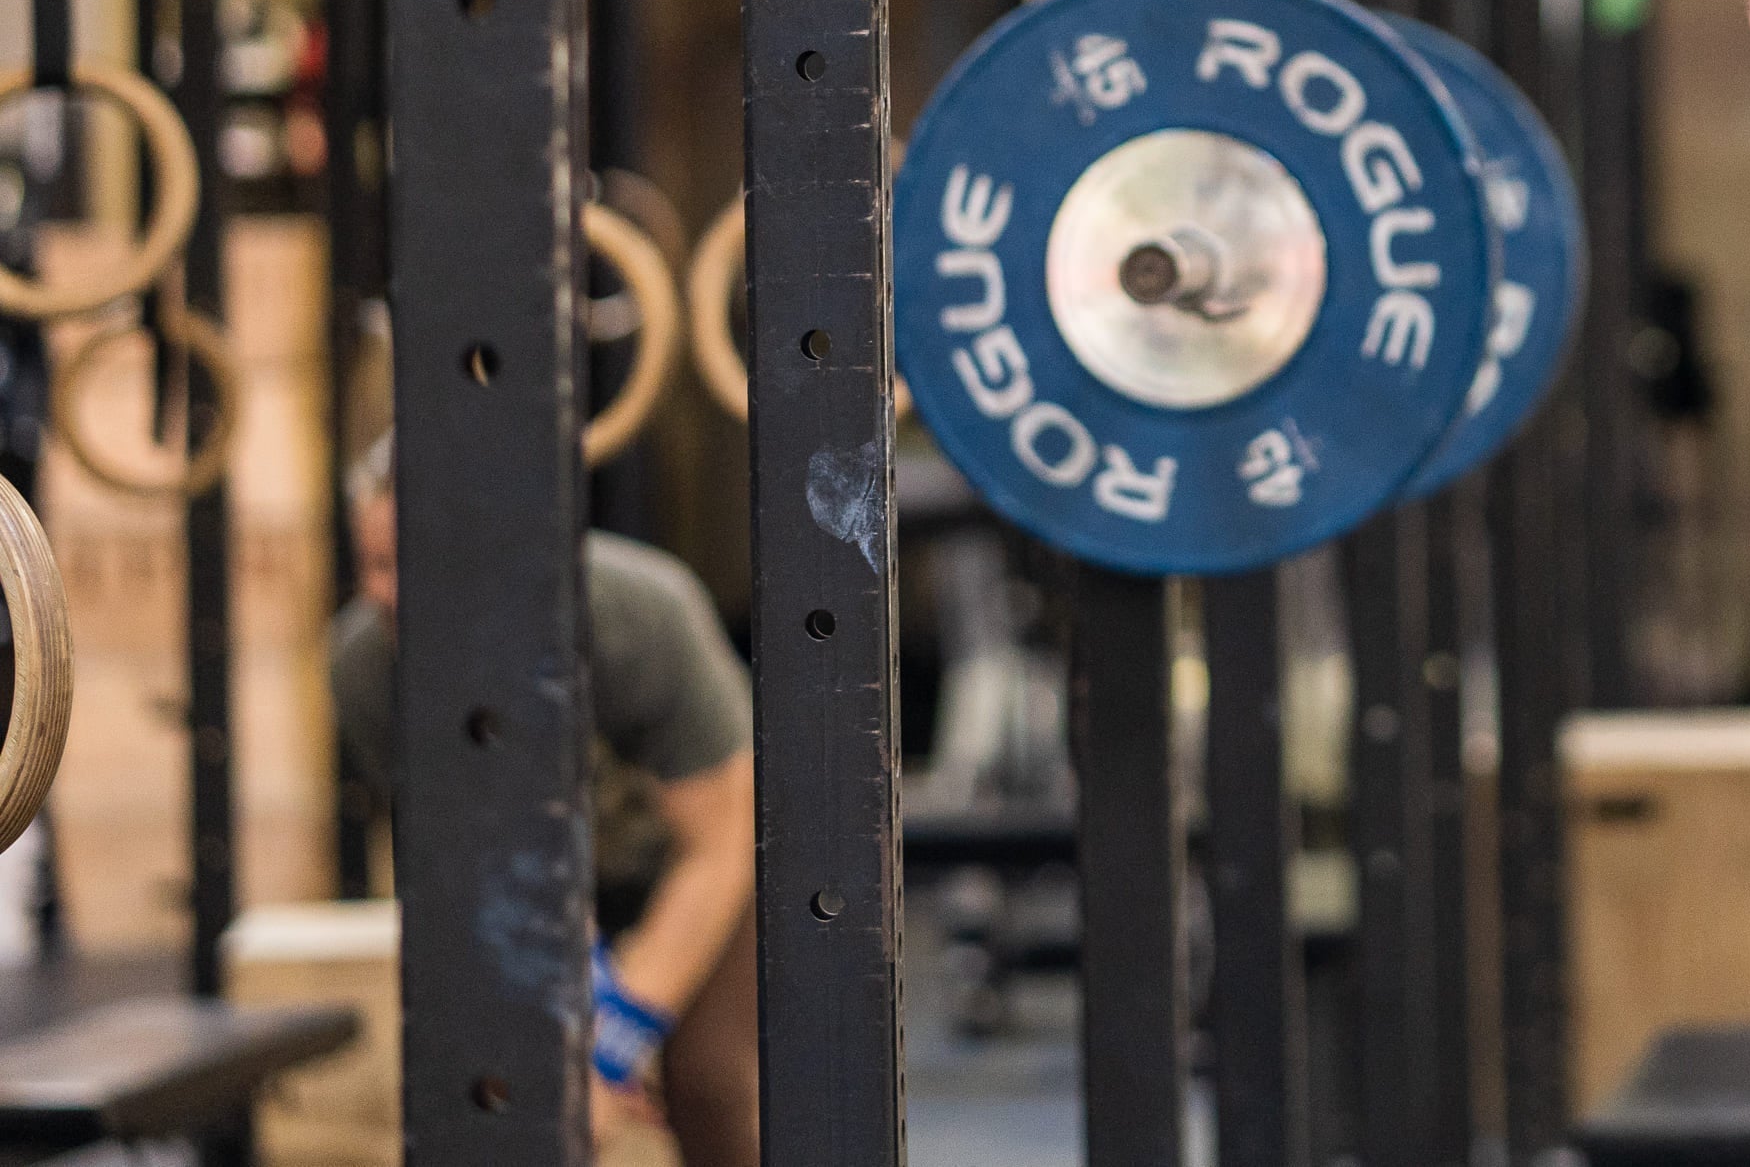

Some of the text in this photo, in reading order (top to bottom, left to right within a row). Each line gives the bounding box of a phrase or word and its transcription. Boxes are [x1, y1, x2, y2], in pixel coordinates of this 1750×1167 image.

[1073, 33, 1146, 108] 45
[1197, 19, 1440, 370] ROGUE
[936, 165, 1177, 522] ROGUE
